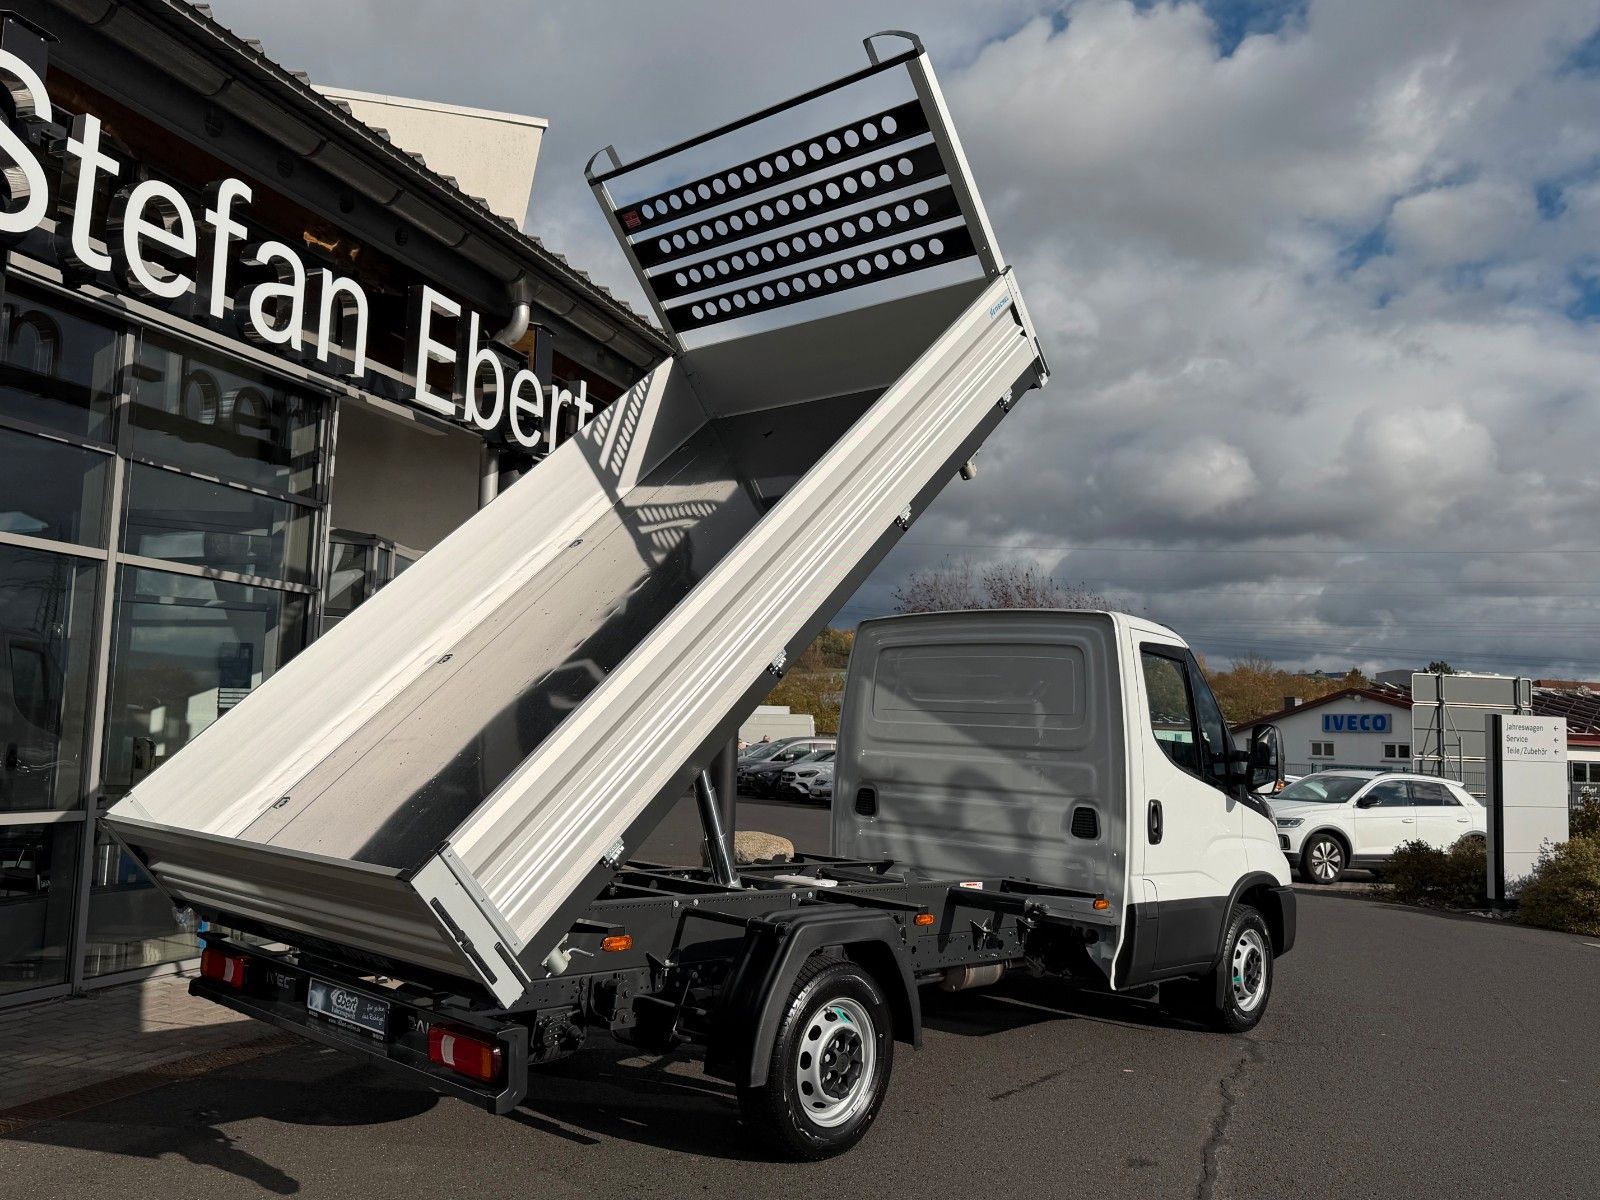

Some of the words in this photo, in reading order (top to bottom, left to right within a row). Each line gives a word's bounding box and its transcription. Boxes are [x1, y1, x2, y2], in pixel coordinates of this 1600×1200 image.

[0, 49, 369, 378] Stefan
[415, 284, 594, 454] Ebert
[1324, 714, 1387, 731] IVECO
[1505, 722, 1544, 734] Jahreswagen
[1505, 734, 1529, 744] Service
[1506, 745, 1548, 756] Teile/Zubehör
[266, 969, 297, 990] IVEC
